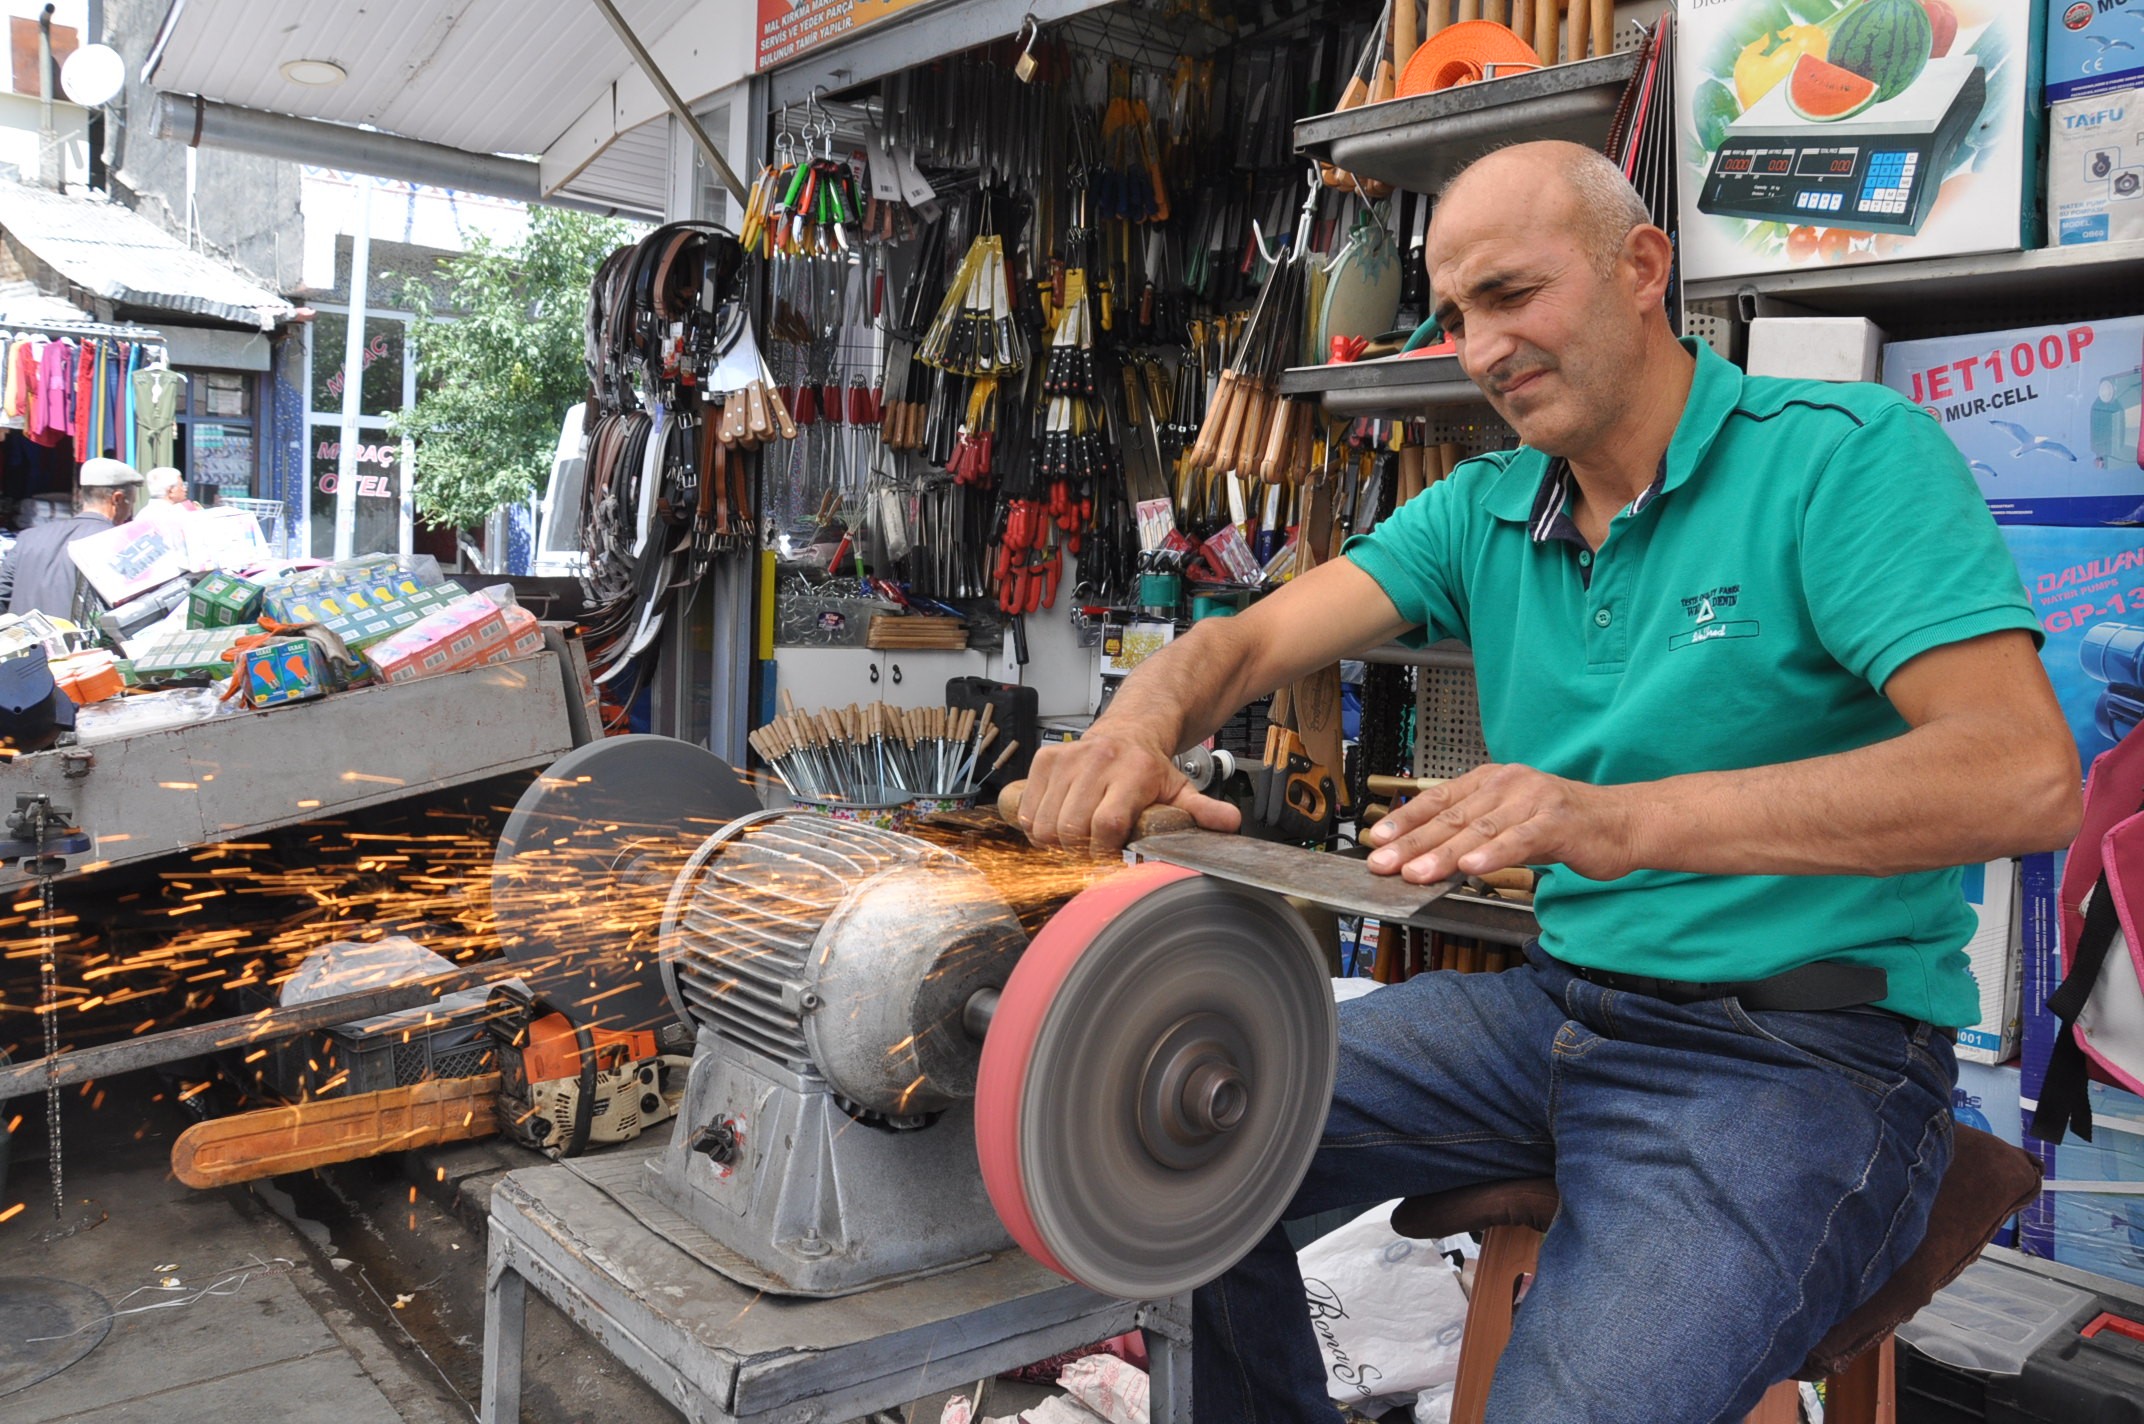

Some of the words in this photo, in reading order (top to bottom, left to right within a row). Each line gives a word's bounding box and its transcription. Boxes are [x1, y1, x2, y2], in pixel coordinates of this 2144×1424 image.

[760, 31, 787, 51] SERVİS
[788, 26, 799, 39] VE
[799, 14, 824, 35] YEDEK
[825, 2, 854, 21] PARÇA
[764, 19, 780, 34] MAL
[759, 45, 795, 68] BULUNUR
[796, 31, 819, 51] TAMİR
[1906, 325, 2095, 405] JET100P
[1945, 384, 2039, 423] MUR-CELL
[318, 472, 392, 498] OEL
[2040, 589, 2078, 606] WATER
[2080, 578, 2120, 595] PUMPS
[1957, 1032, 1982, 1045] 001
